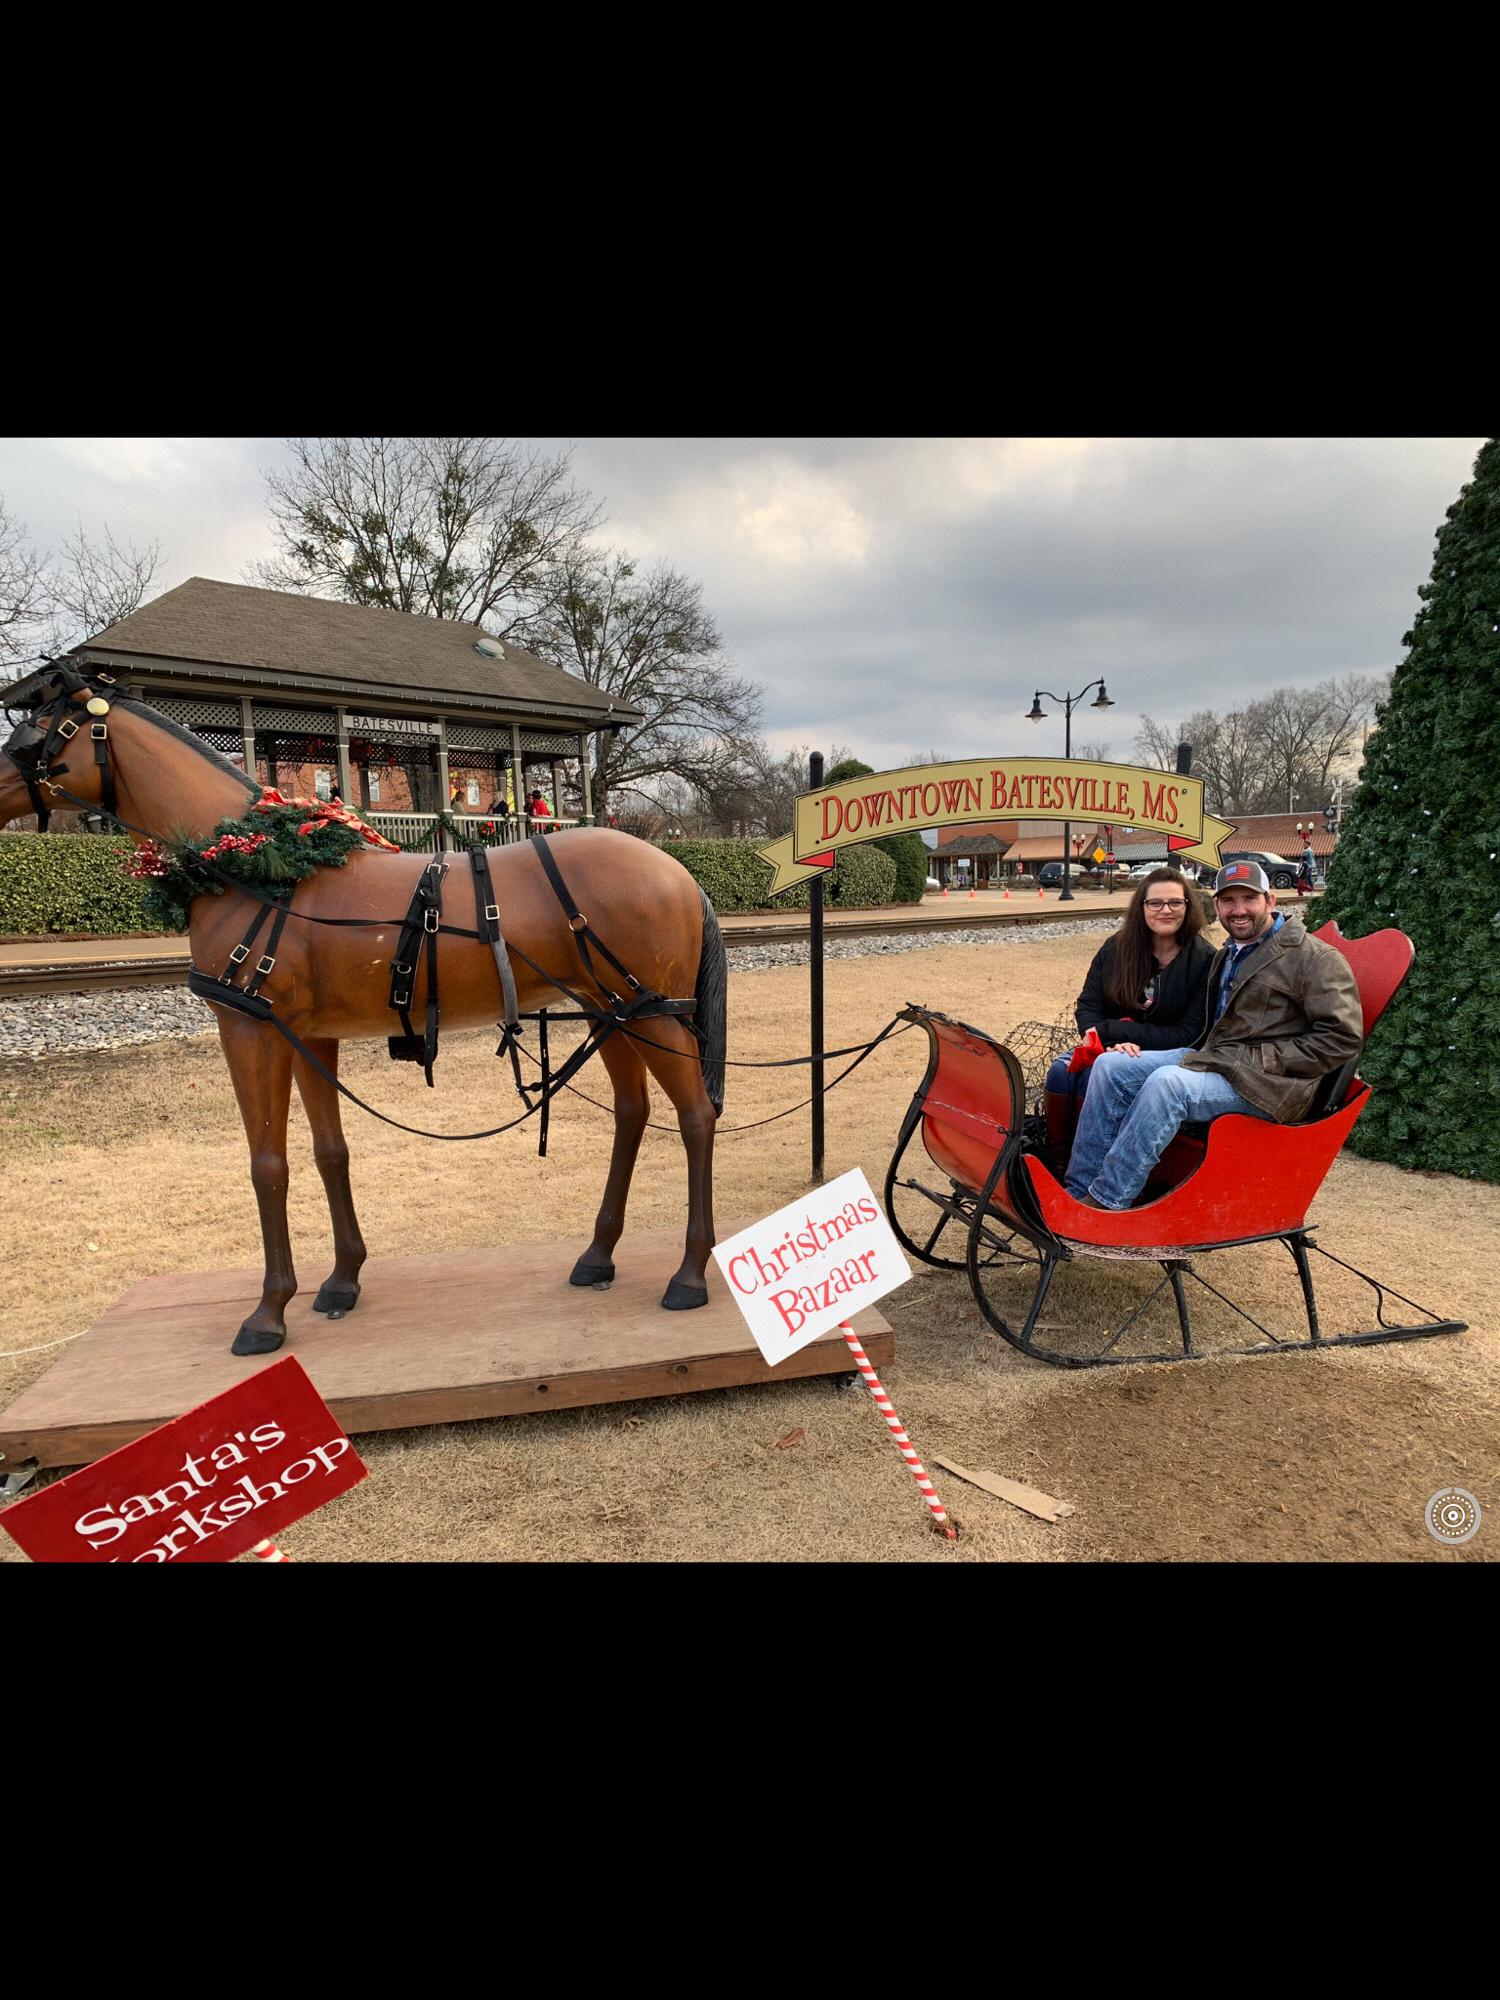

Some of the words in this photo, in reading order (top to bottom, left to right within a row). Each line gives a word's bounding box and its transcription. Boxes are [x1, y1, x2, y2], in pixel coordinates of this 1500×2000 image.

[352, 716, 433, 734] BATESVILLE
[821, 777, 983, 841] DOWNTOWN
[990, 770, 1135, 820] BATESVILLE,
[1141, 780, 1179, 824] MS
[728, 1198, 878, 1295] Christmas
[768, 1249, 879, 1336] Bazaar
[74, 1420, 286, 1550] Santa's
[109, 1437, 350, 1562] orkshop
